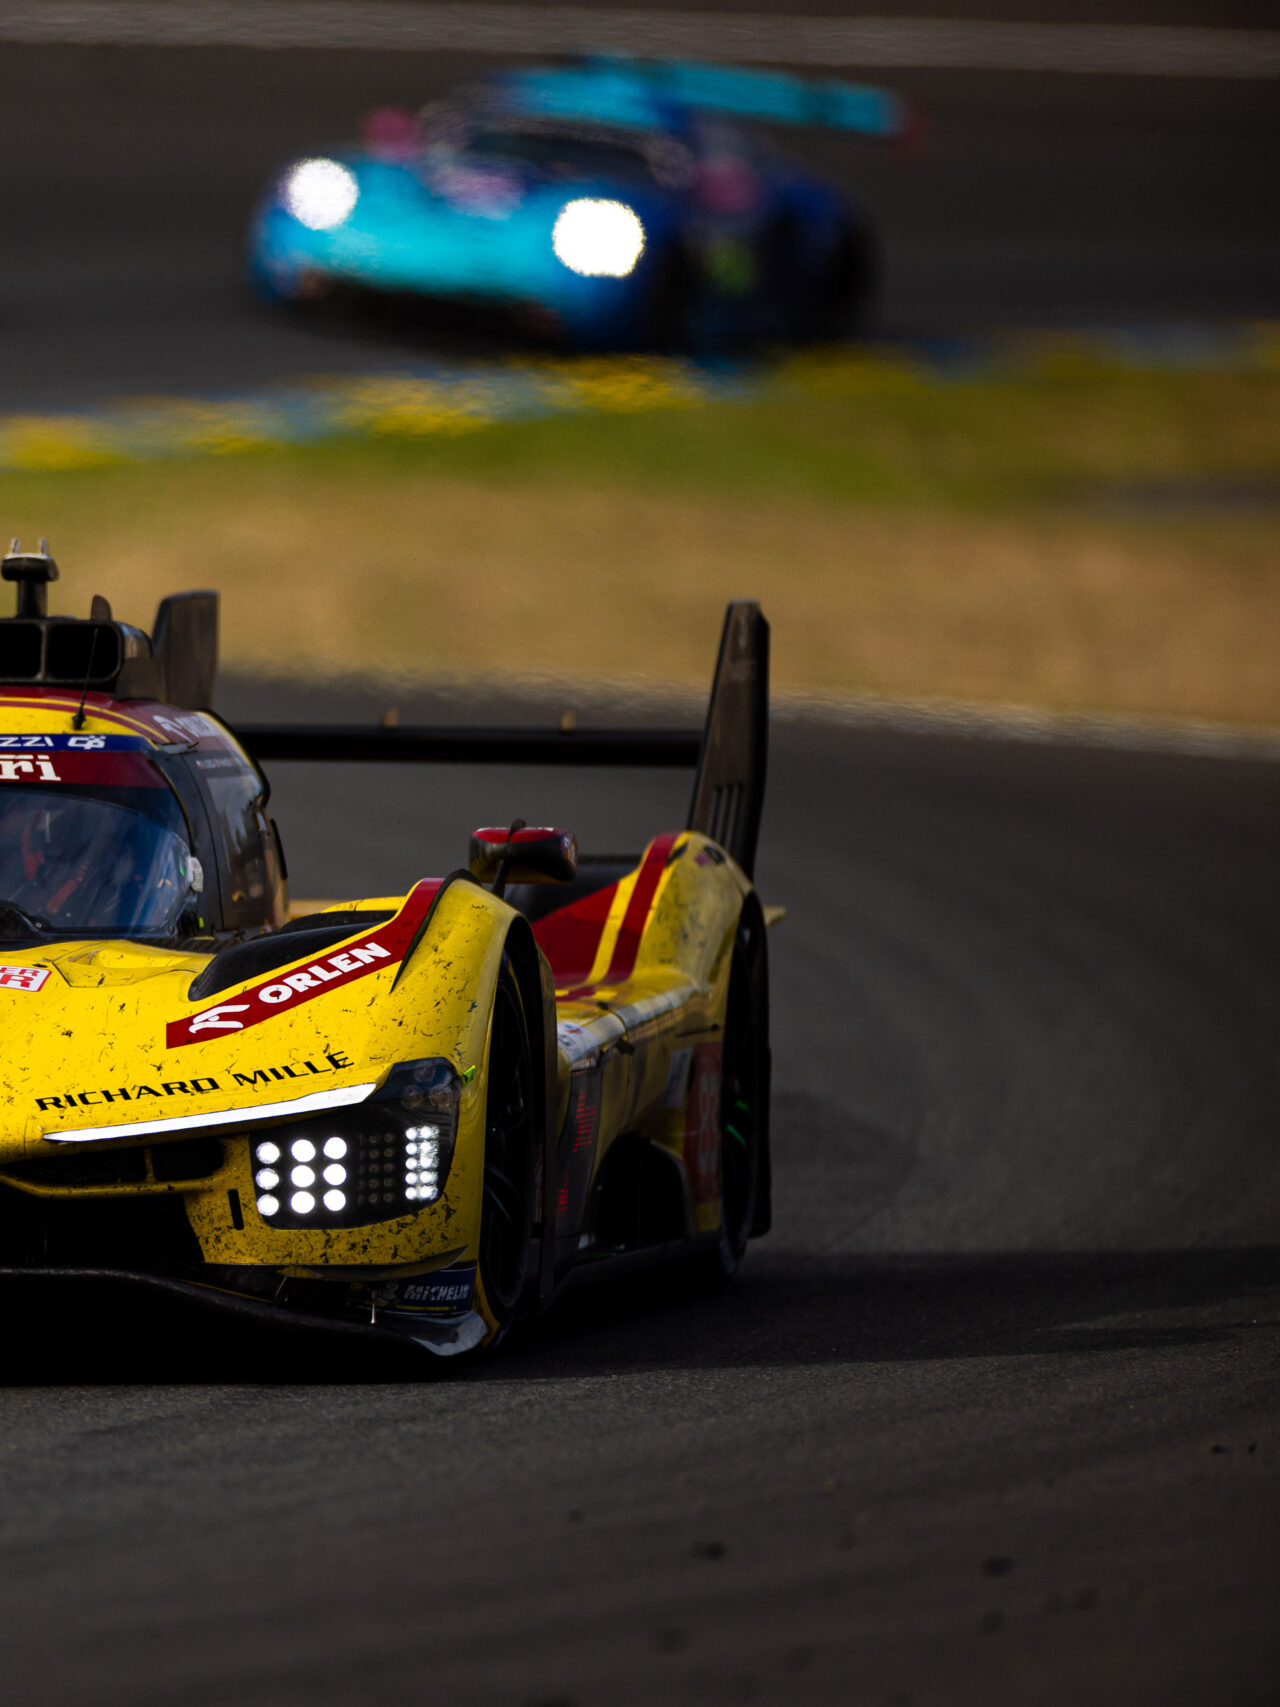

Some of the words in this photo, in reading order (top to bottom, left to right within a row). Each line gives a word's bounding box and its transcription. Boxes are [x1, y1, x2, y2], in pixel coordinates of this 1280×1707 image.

[258, 942, 391, 1003] ORLEN
[35, 1077, 220, 1112] RICHARD
[232, 1051, 355, 1087] MILLE
[403, 1284, 469, 1300] MICHELIN
